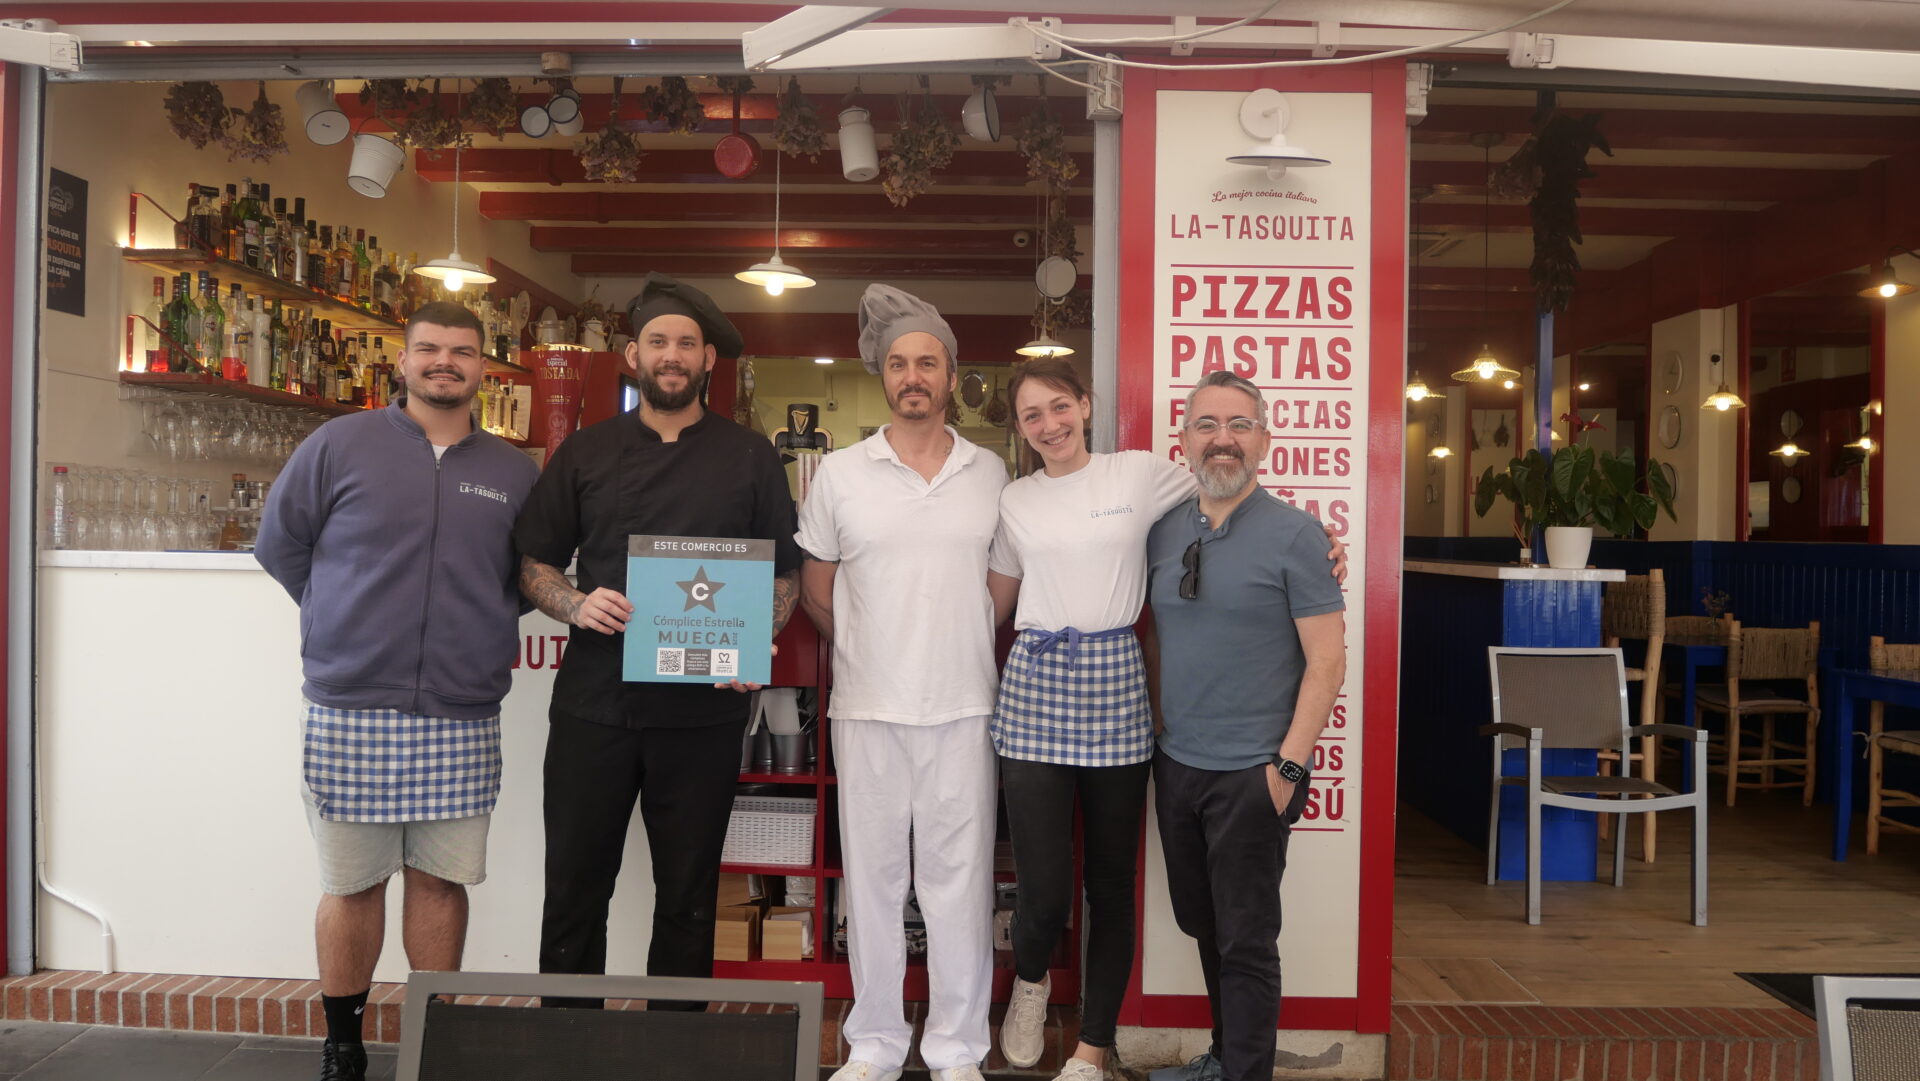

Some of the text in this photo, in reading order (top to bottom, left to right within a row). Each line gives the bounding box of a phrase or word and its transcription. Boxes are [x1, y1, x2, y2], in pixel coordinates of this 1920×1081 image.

[1212, 189, 1318, 204] La mejor cocina italiana
[1170, 214, 1354, 241] LA-TASQUITA
[1171, 274, 1353, 321] PIZZAS
[1170, 334, 1352, 381] PASTAS
[460, 485, 508, 504] LA-TASQUITA
[654, 541, 747, 553] ESTE COMERCIO ES
[691, 582, 710, 601] C
[653, 615, 745, 629] Cómplice Estrella
[658, 630, 731, 646] MUECA
